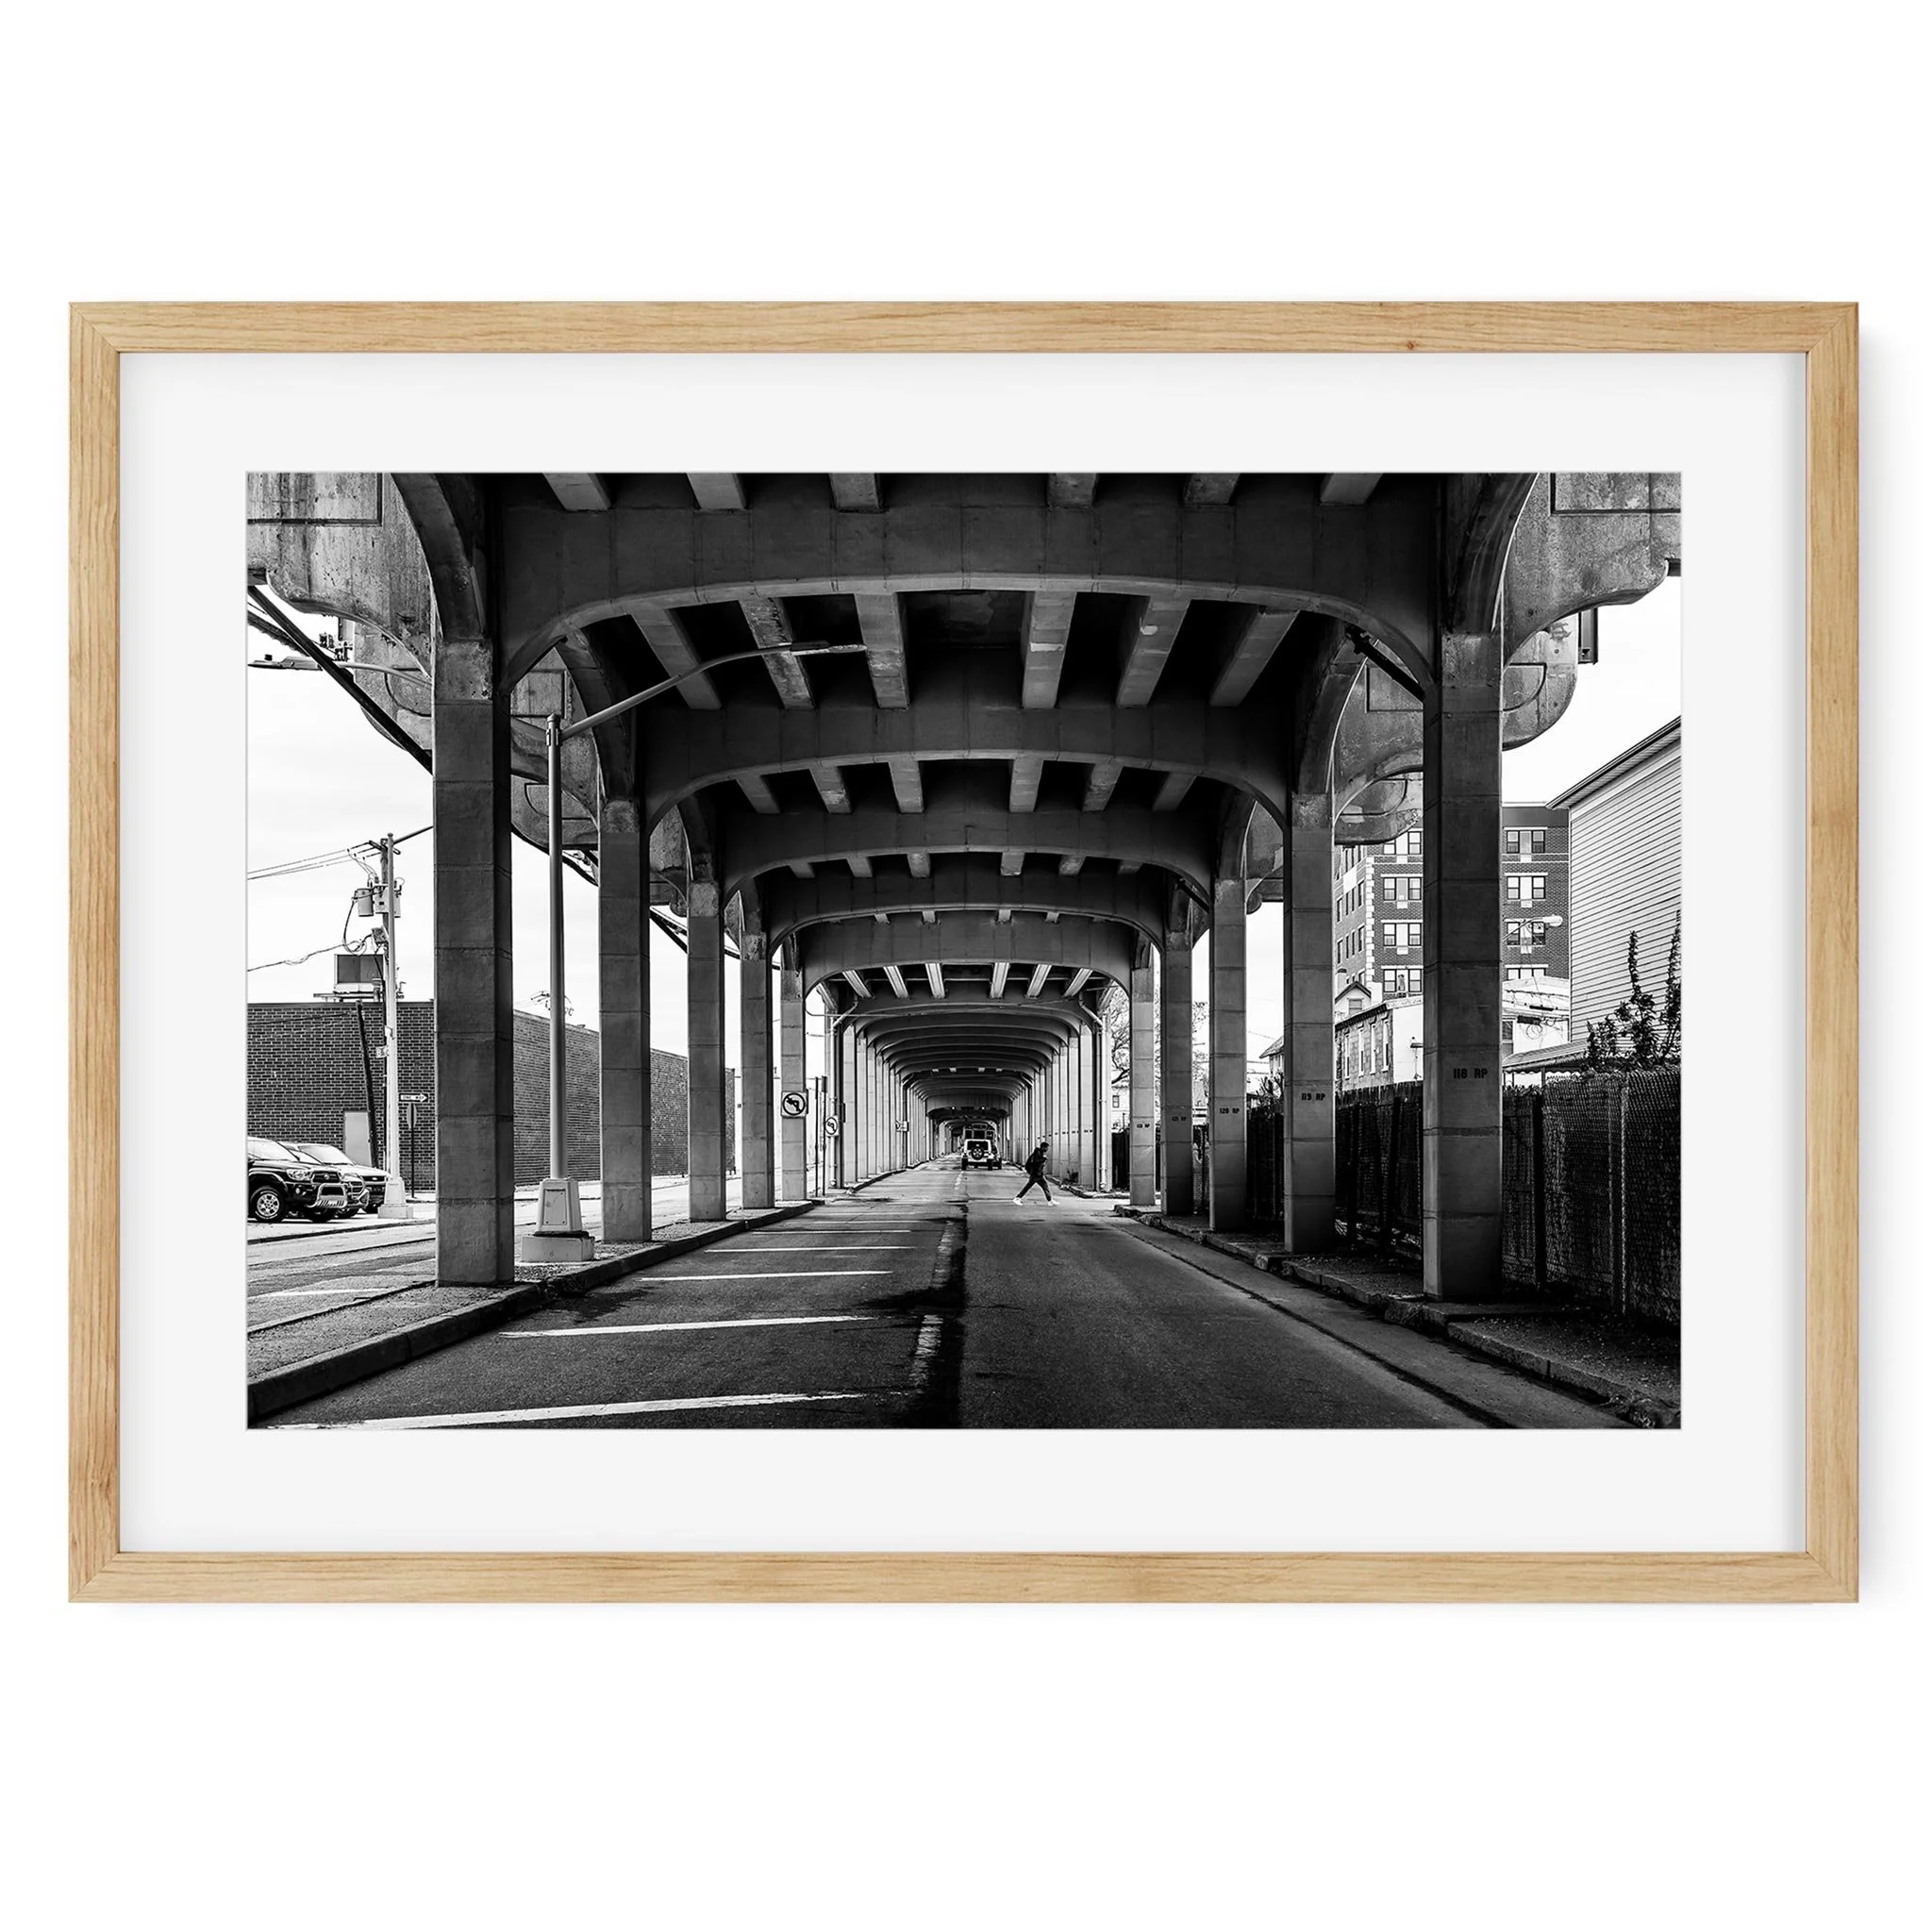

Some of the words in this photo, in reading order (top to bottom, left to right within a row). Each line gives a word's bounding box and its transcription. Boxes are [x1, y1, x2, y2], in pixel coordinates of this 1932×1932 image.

[1453, 1067, 1468, 1079] 118
[1474, 1067, 1489, 1079] RP
[1301, 1092, 1312, 1101] 119
[1315, 1092, 1326, 1101] RP
